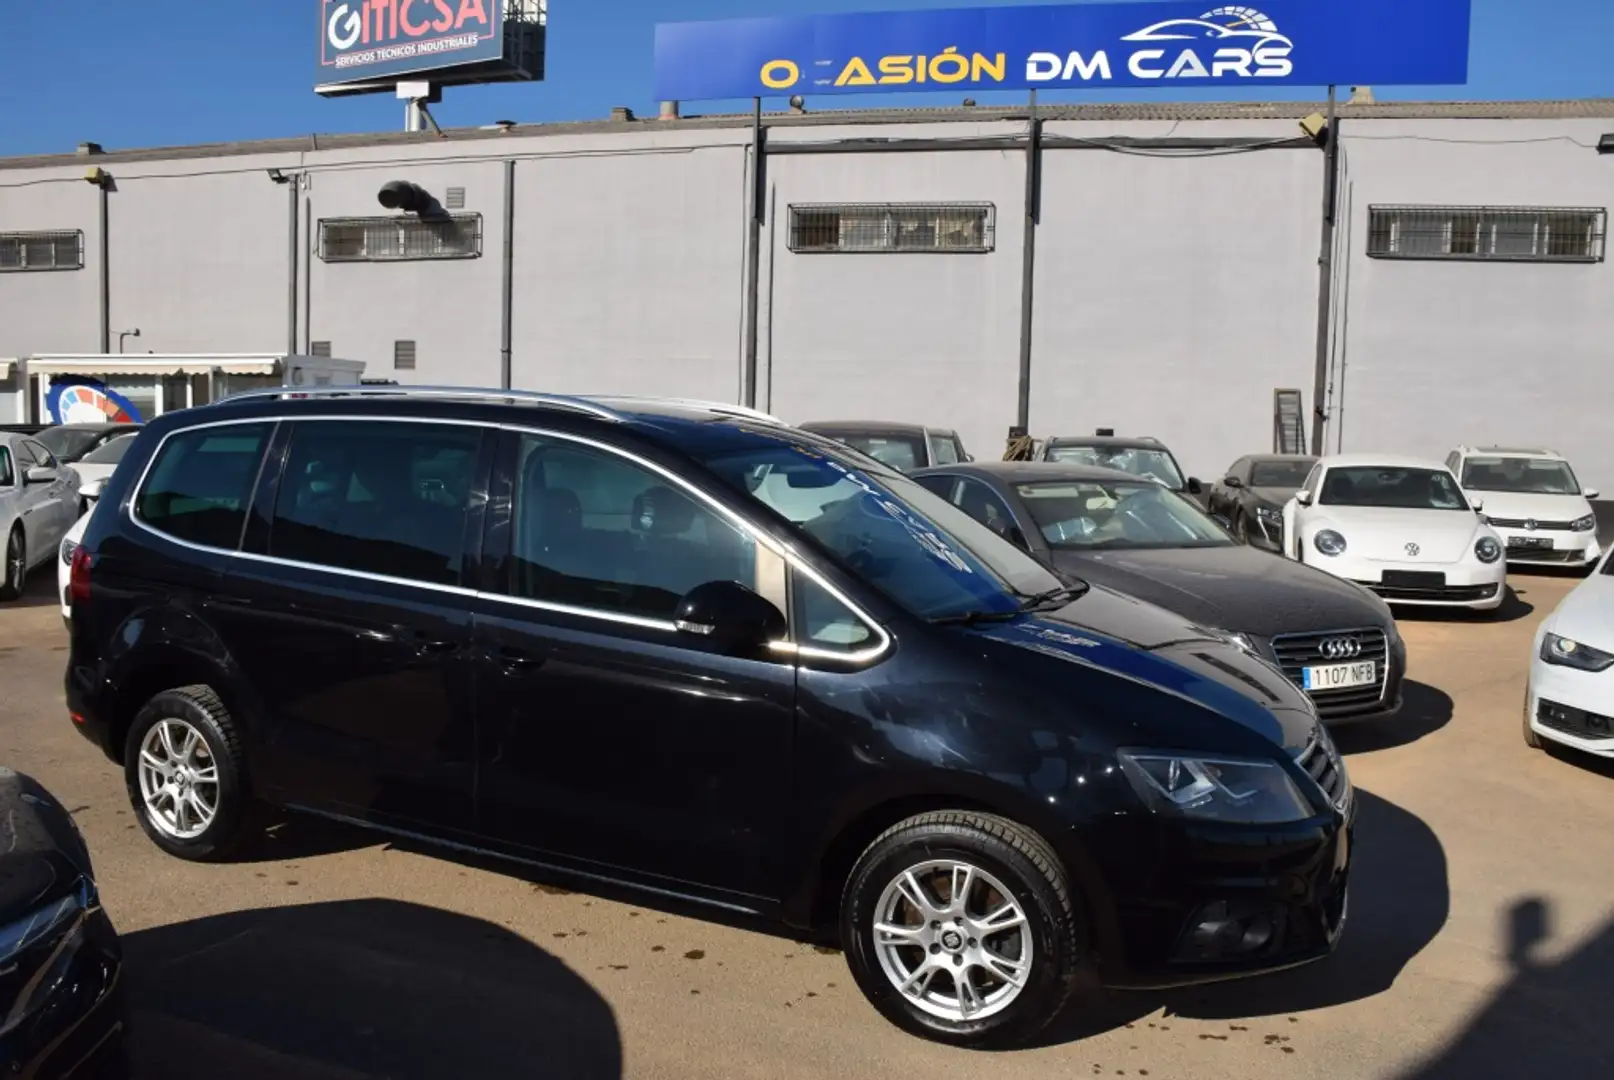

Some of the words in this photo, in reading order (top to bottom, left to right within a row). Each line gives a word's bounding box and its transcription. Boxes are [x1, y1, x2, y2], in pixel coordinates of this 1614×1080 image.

[328, 0, 488, 49] GITICSA
[335, 51, 375, 67] SERVICIOS
[417, 34, 479, 54] INDUSTRIALES
[760, 46, 1006, 89] OASIÓN
[1026, 50, 1112, 81] DM
[1128, 48, 1293, 79] CARS
[1315, 666, 1348, 685] 1107
[1351, 663, 1373, 682] NFB
